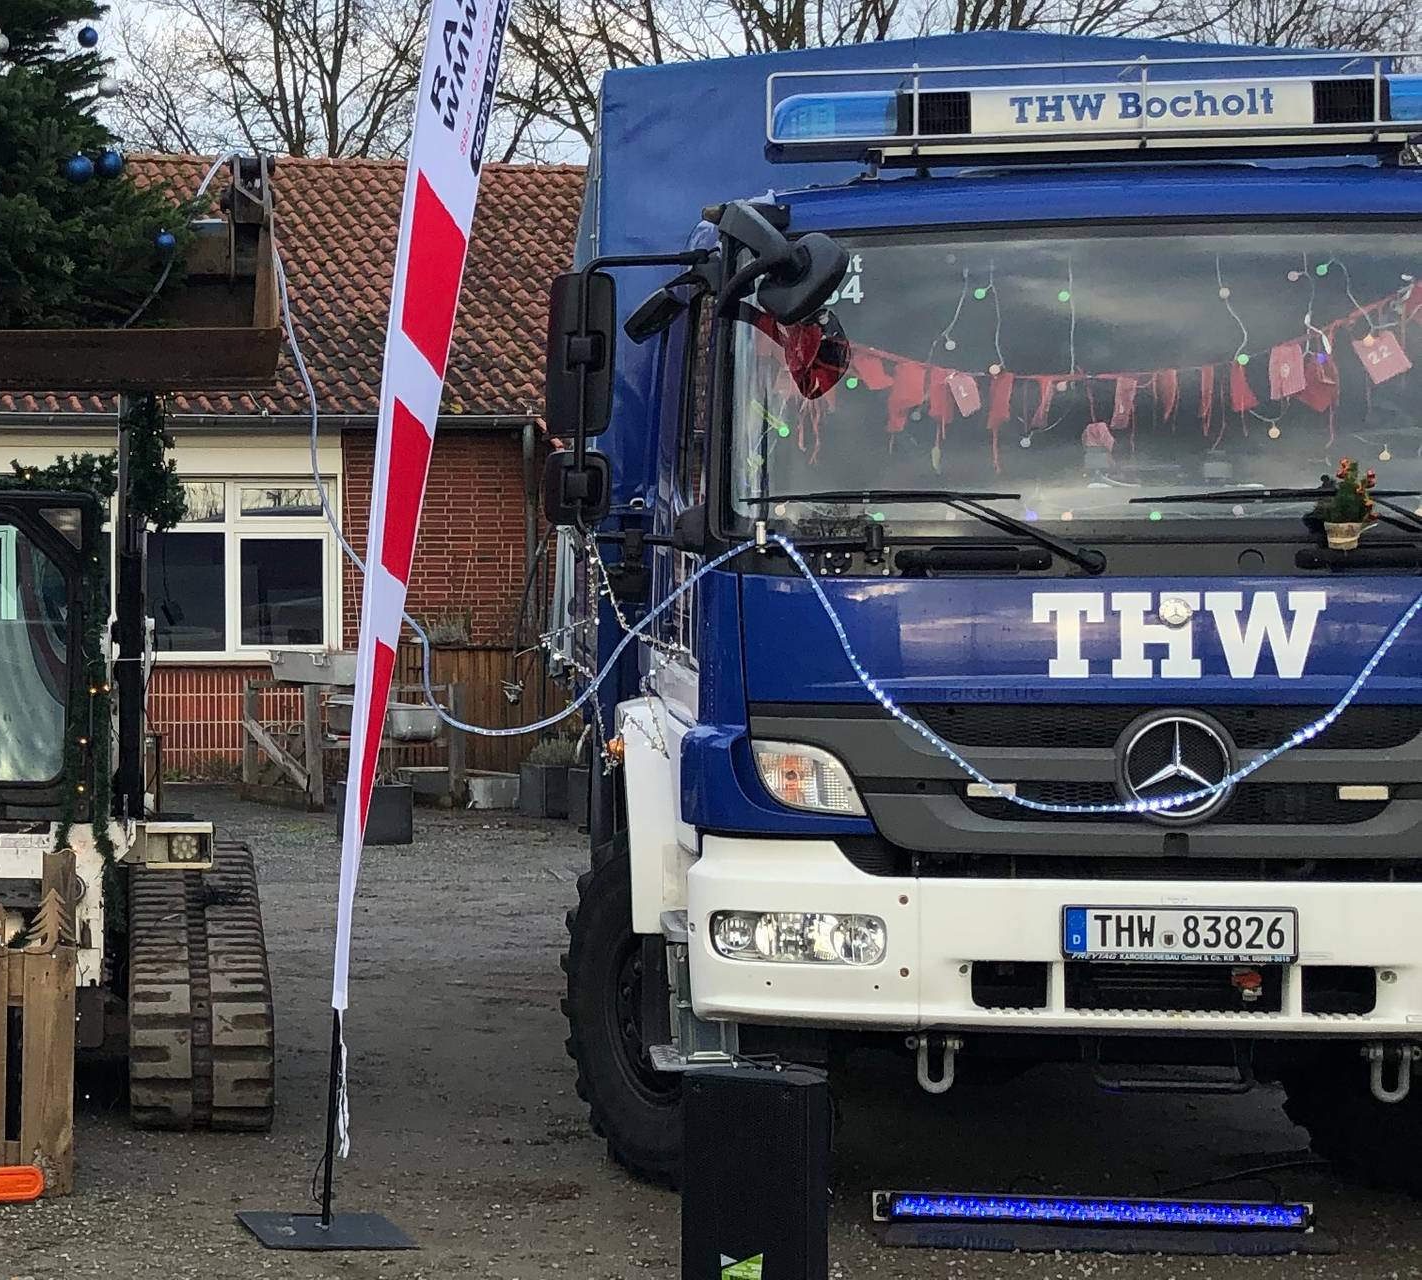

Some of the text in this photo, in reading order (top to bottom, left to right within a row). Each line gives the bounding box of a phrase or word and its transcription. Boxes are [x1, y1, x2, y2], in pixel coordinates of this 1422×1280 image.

[430, 0, 463, 114] RA
[1009, 87, 1275, 124] THW Bocholt
[1032, 591, 1327, 679] THW
[1072, 914, 1286, 950] D THW 83826
